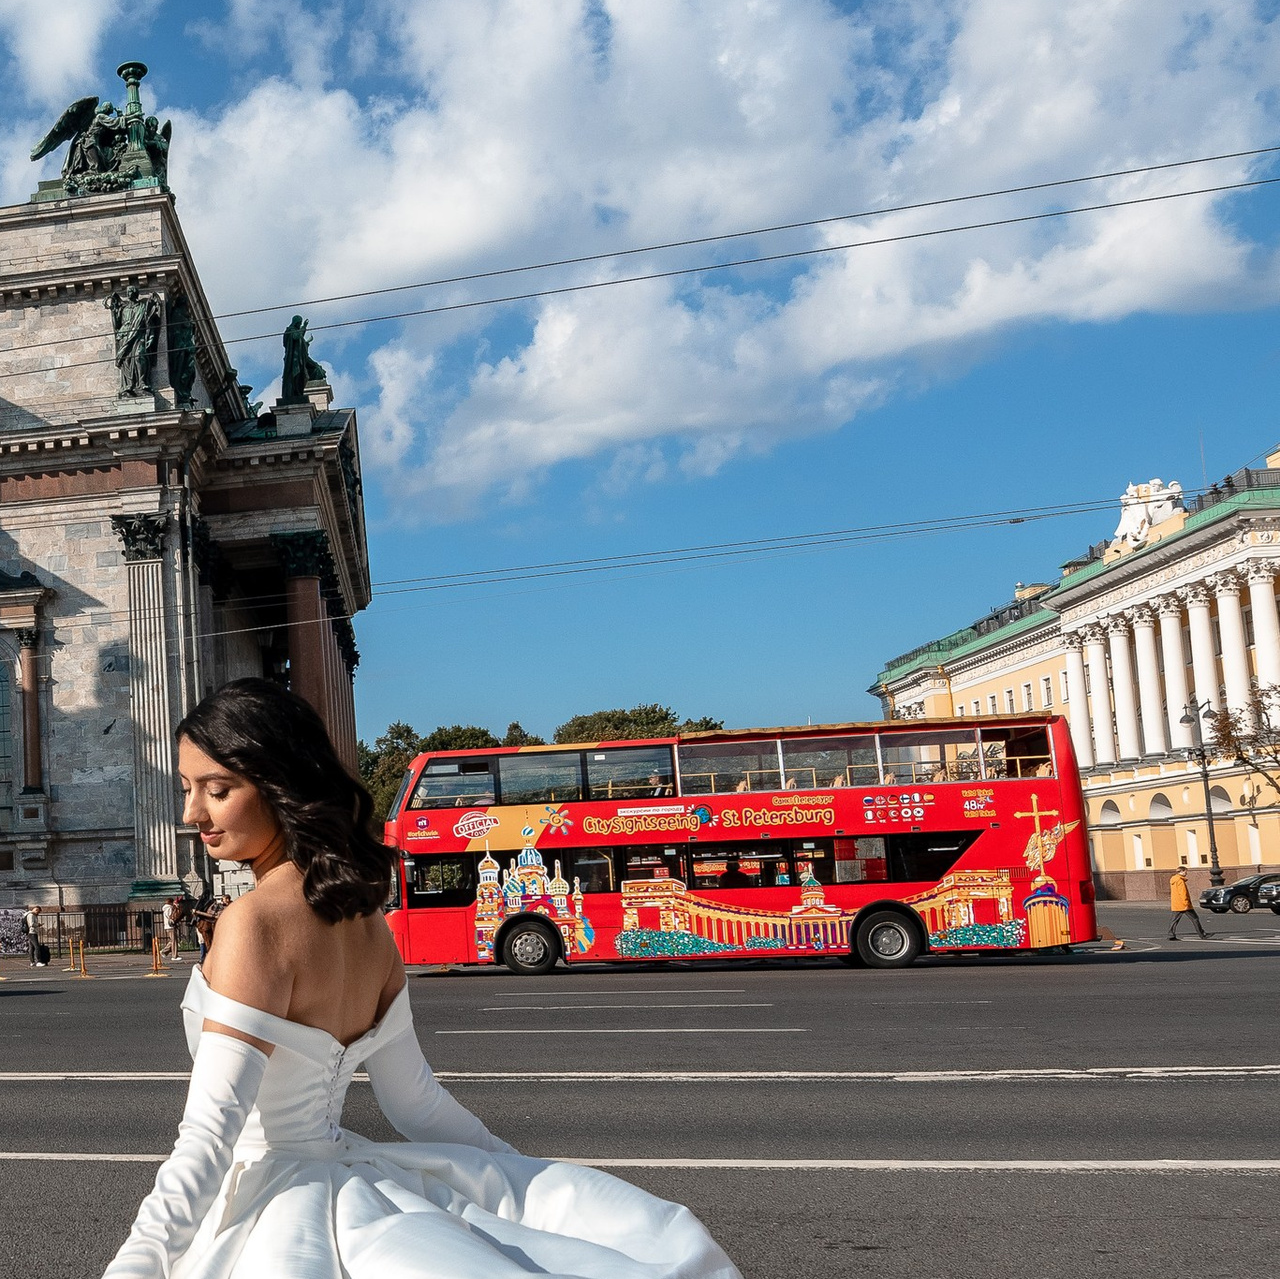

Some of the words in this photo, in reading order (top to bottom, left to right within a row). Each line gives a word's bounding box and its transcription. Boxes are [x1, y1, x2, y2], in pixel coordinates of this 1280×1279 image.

[458, 819, 497, 834] OFFICIAL
[583, 813, 701, 835] CitySightseeing
[721, 808, 741, 827] St
[741, 806, 835, 827] Petersburg
